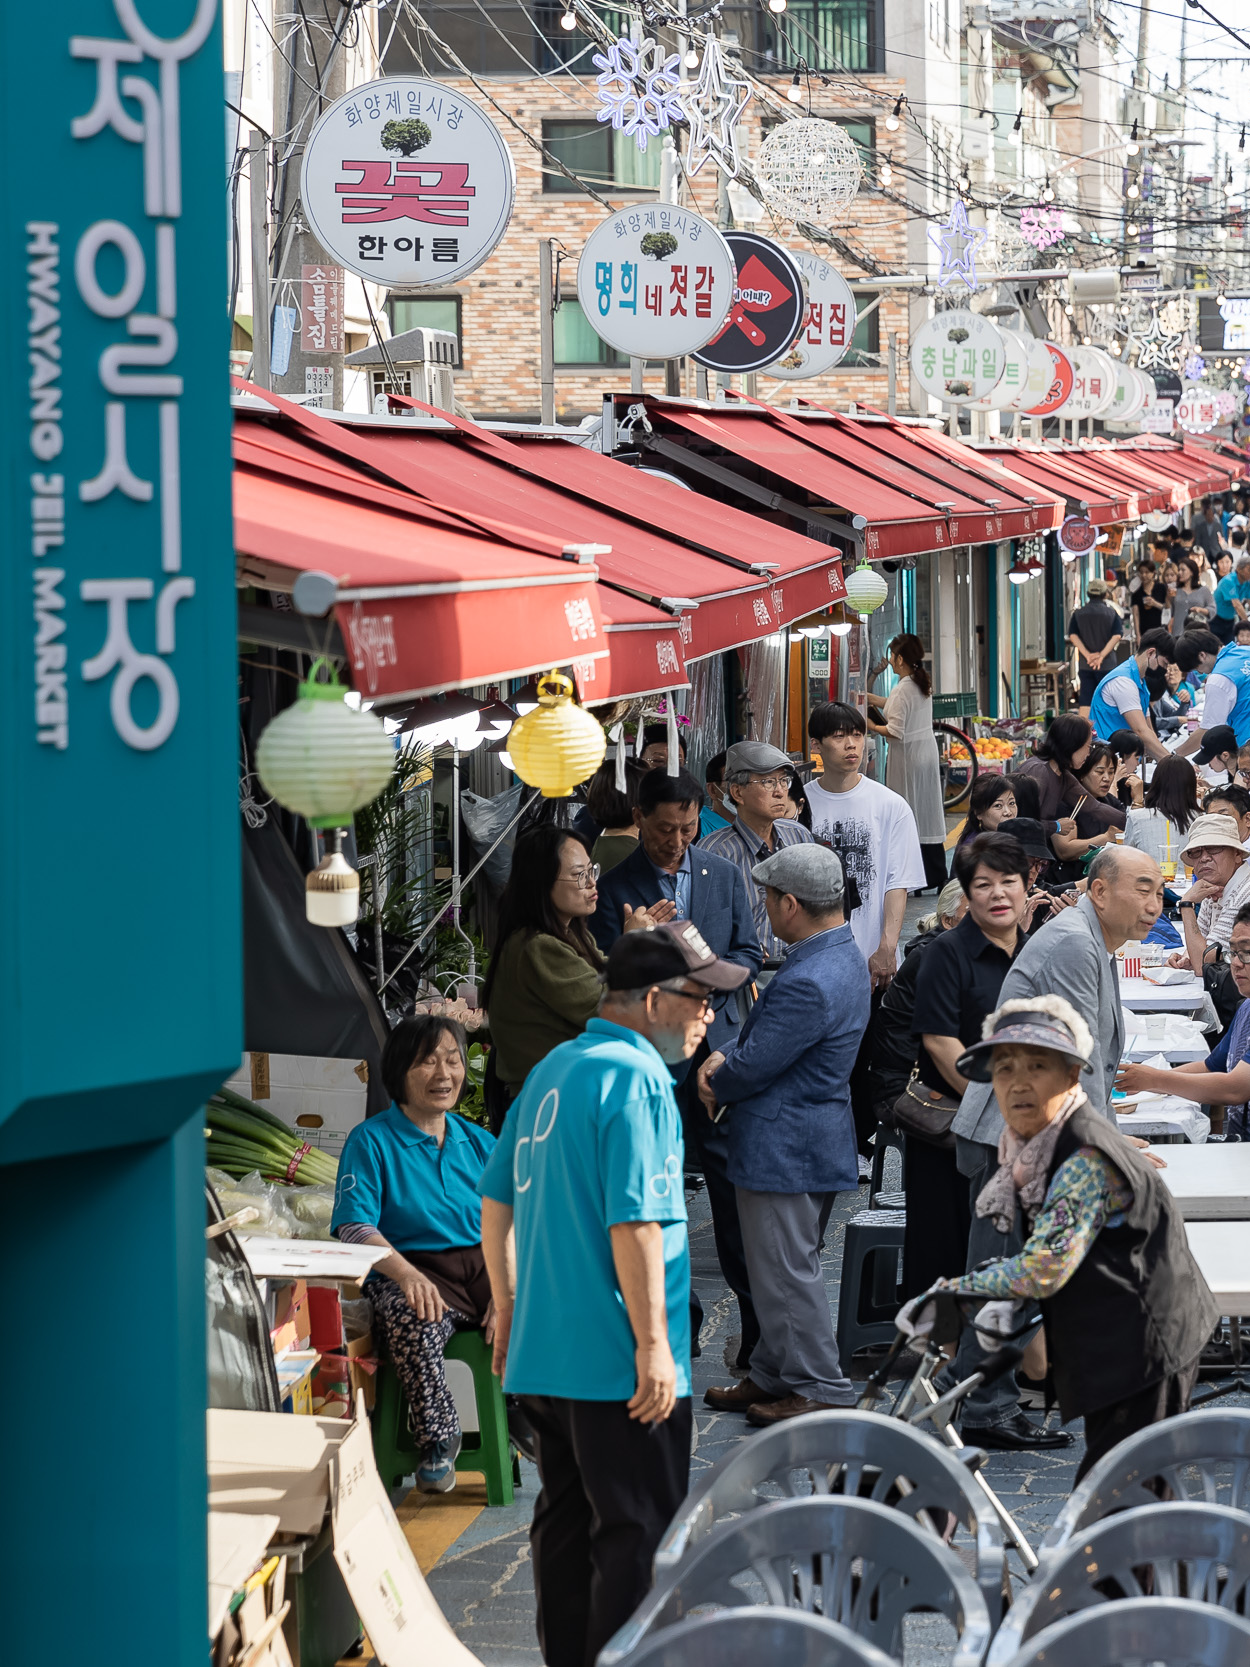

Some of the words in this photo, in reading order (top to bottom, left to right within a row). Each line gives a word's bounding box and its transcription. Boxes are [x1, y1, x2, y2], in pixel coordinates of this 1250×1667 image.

[345, 90, 464, 131] 화양제일시장
[335, 160, 476, 227] 꽃
[358, 235, 459, 262] 한아름
[614, 211, 703, 242] 화양제일시장
[307, 267, 329, 349] 솜틀집
[26, 220, 64, 461] HWAYANG
[920, 348, 997, 380] 충남과일
[1179, 403, 1213, 422] 이불
[30, 472, 66, 557] JEIL
[33, 567, 68, 750] MARKET
